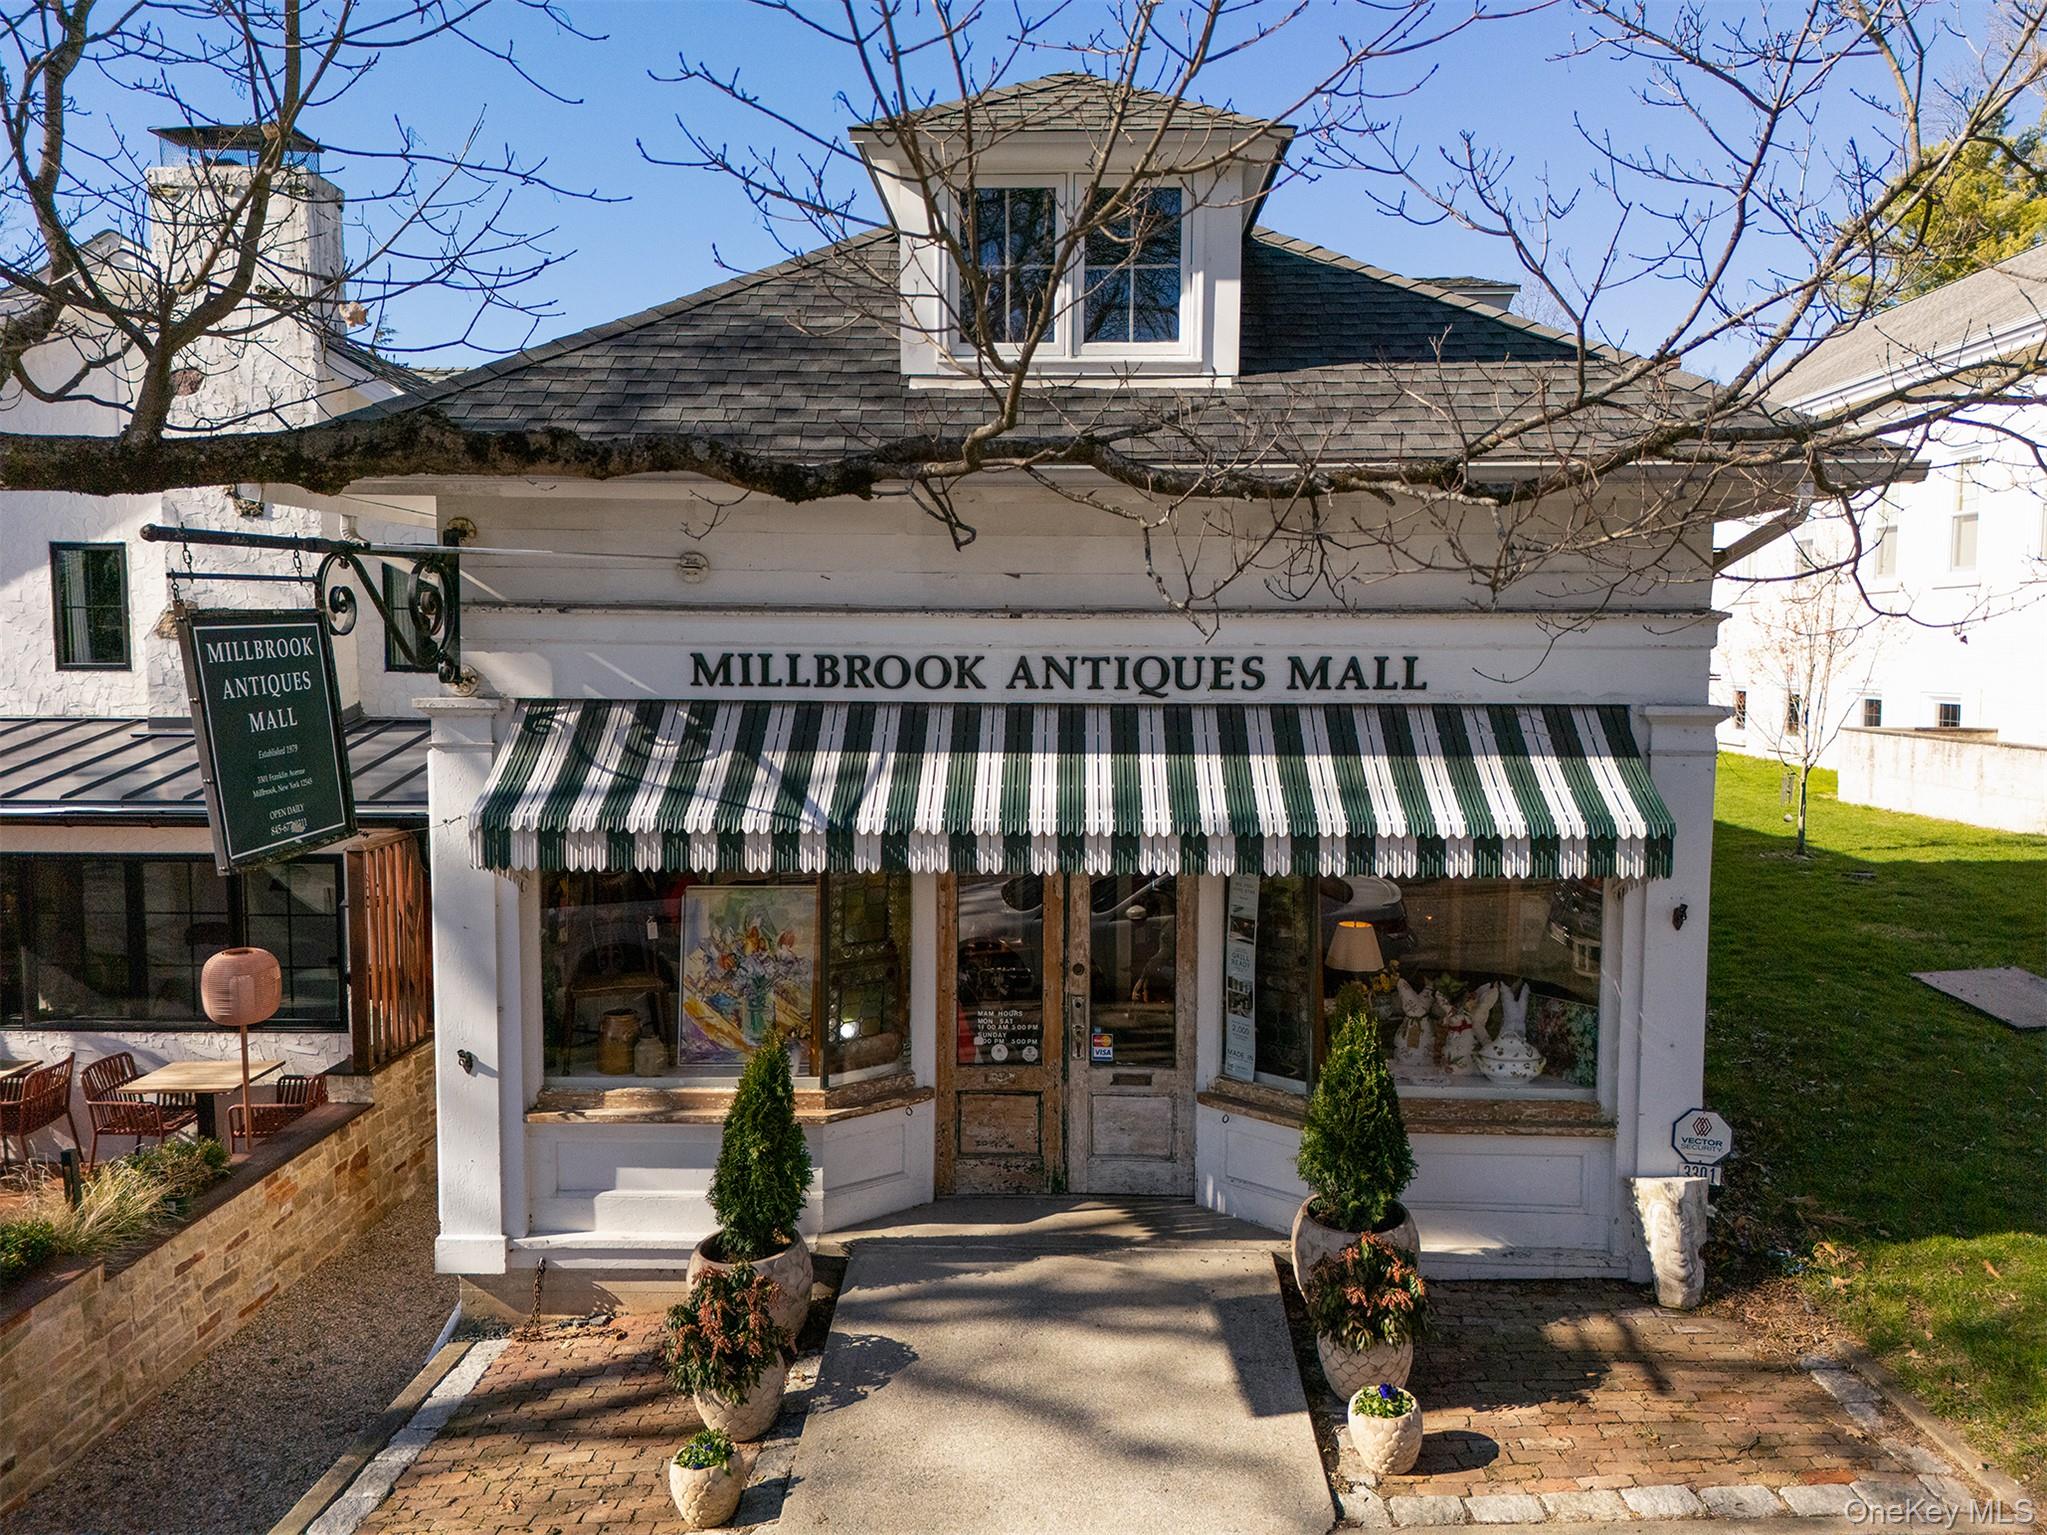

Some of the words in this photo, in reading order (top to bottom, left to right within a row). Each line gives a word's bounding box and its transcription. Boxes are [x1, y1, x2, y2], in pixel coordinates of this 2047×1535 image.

[206, 636, 314, 664] MILLBROOK
[690, 653, 986, 689] MILLBROOK
[1006, 654, 1265, 698] ANTIQUES
[1287, 655, 1428, 691] MALL
[223, 671, 312, 700] ANTIQUES
[249, 707, 298, 733] MALL
[258, 746, 286, 759] Established
[269, 771, 288, 783] Franklin
[278, 784, 289, 792] New
[289, 781, 300, 789] York
[269, 808, 287, 820] OPEN
[286, 803, 305, 816] DAILY
[1680, 1143, 1724, 1152] SECURITY
[1681, 1137, 1723, 1147] VECTOR
[1683, 1165, 1716, 1184] 3301
